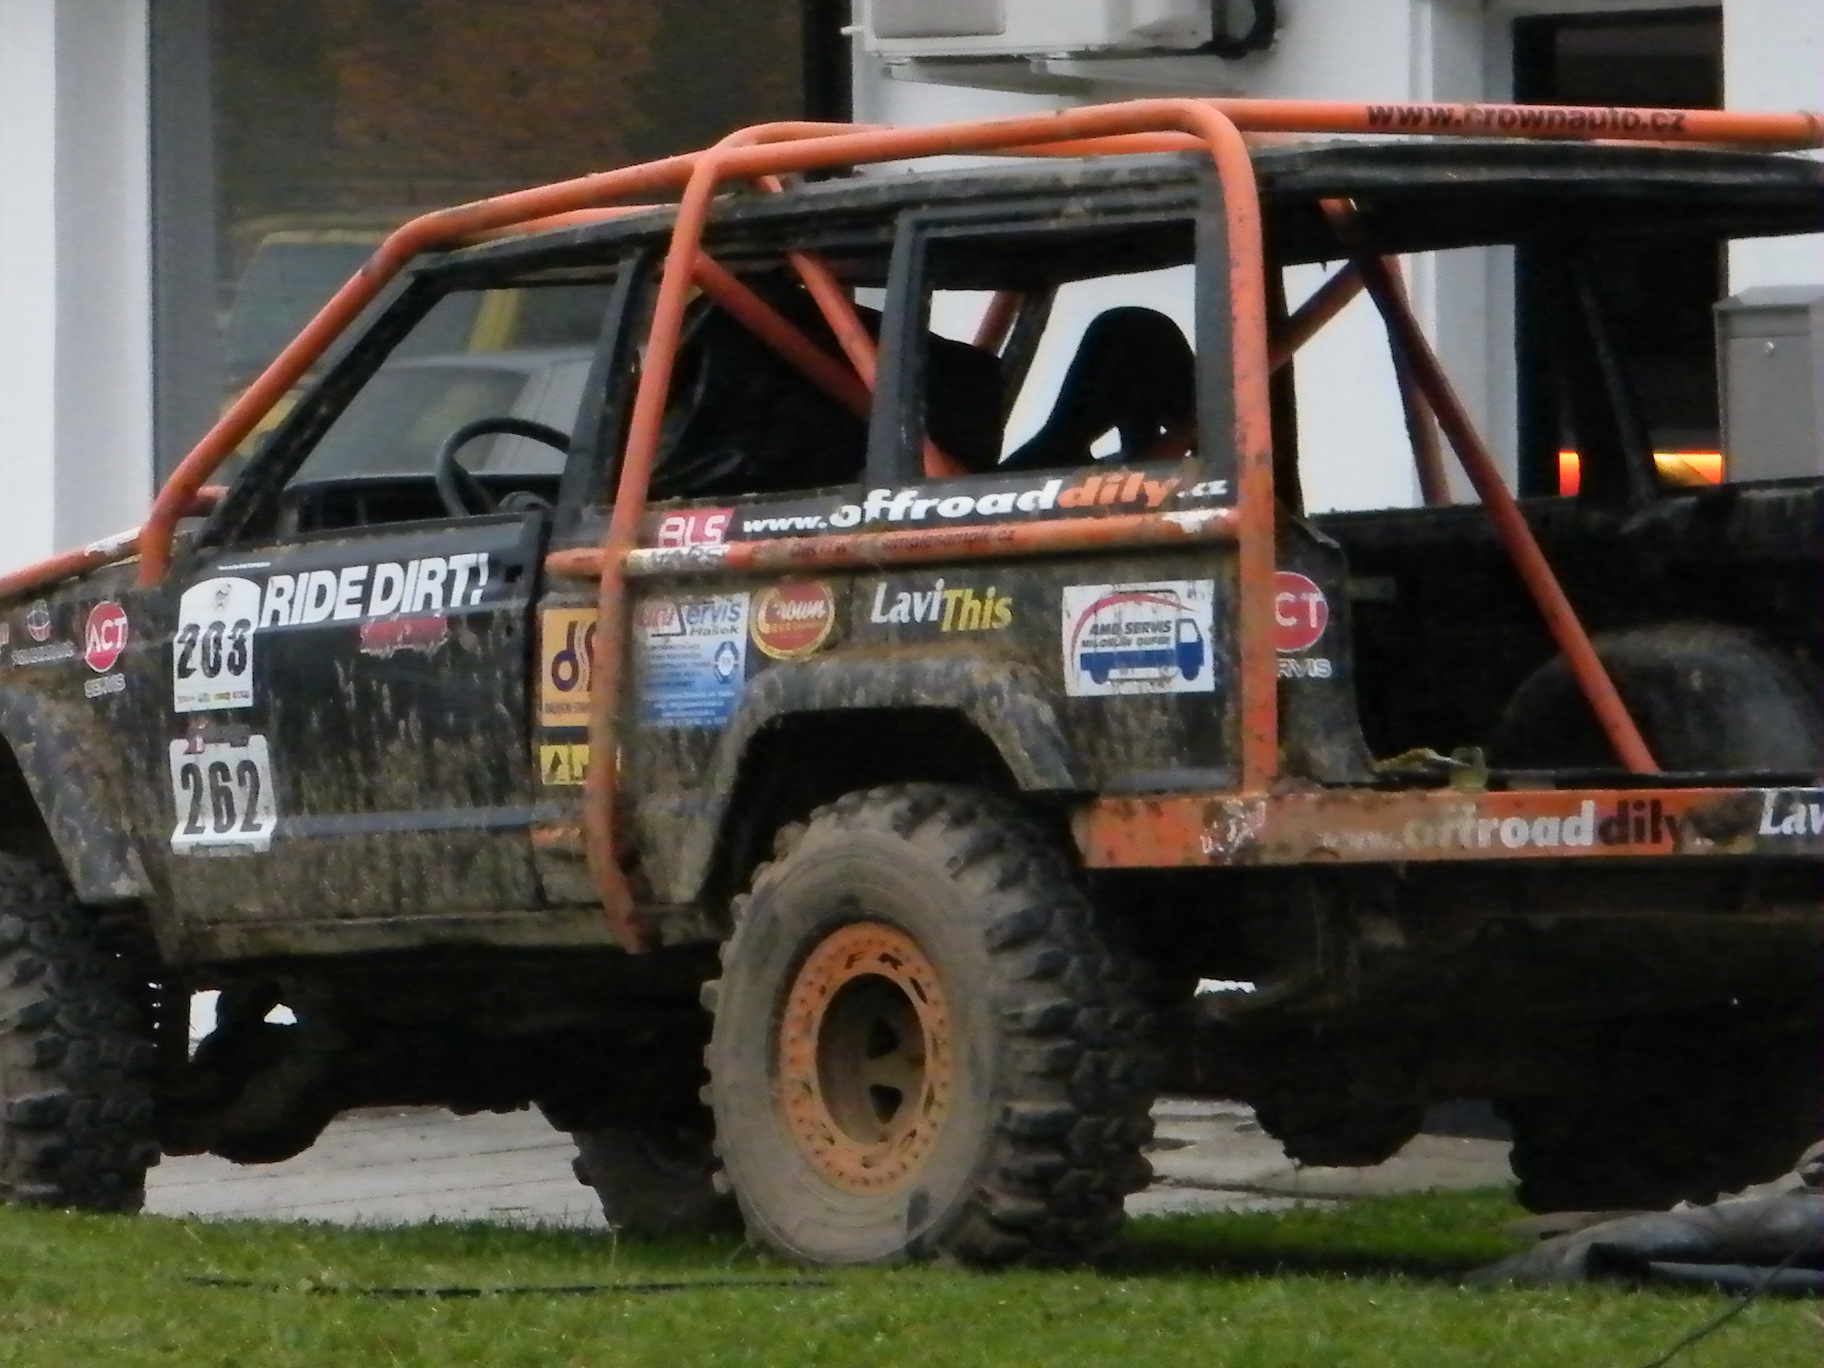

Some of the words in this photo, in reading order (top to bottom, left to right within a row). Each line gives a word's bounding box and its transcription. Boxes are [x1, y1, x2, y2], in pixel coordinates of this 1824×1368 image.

[259, 565, 369, 629] RIDE
[368, 553, 489, 617] DIRT!
[1276, 592, 1326, 628] CT
[86, 617, 127, 657] ACT
[177, 618, 251, 679] 203
[1277, 658, 1332, 678] RVIS
[181, 760, 263, 835] 262
